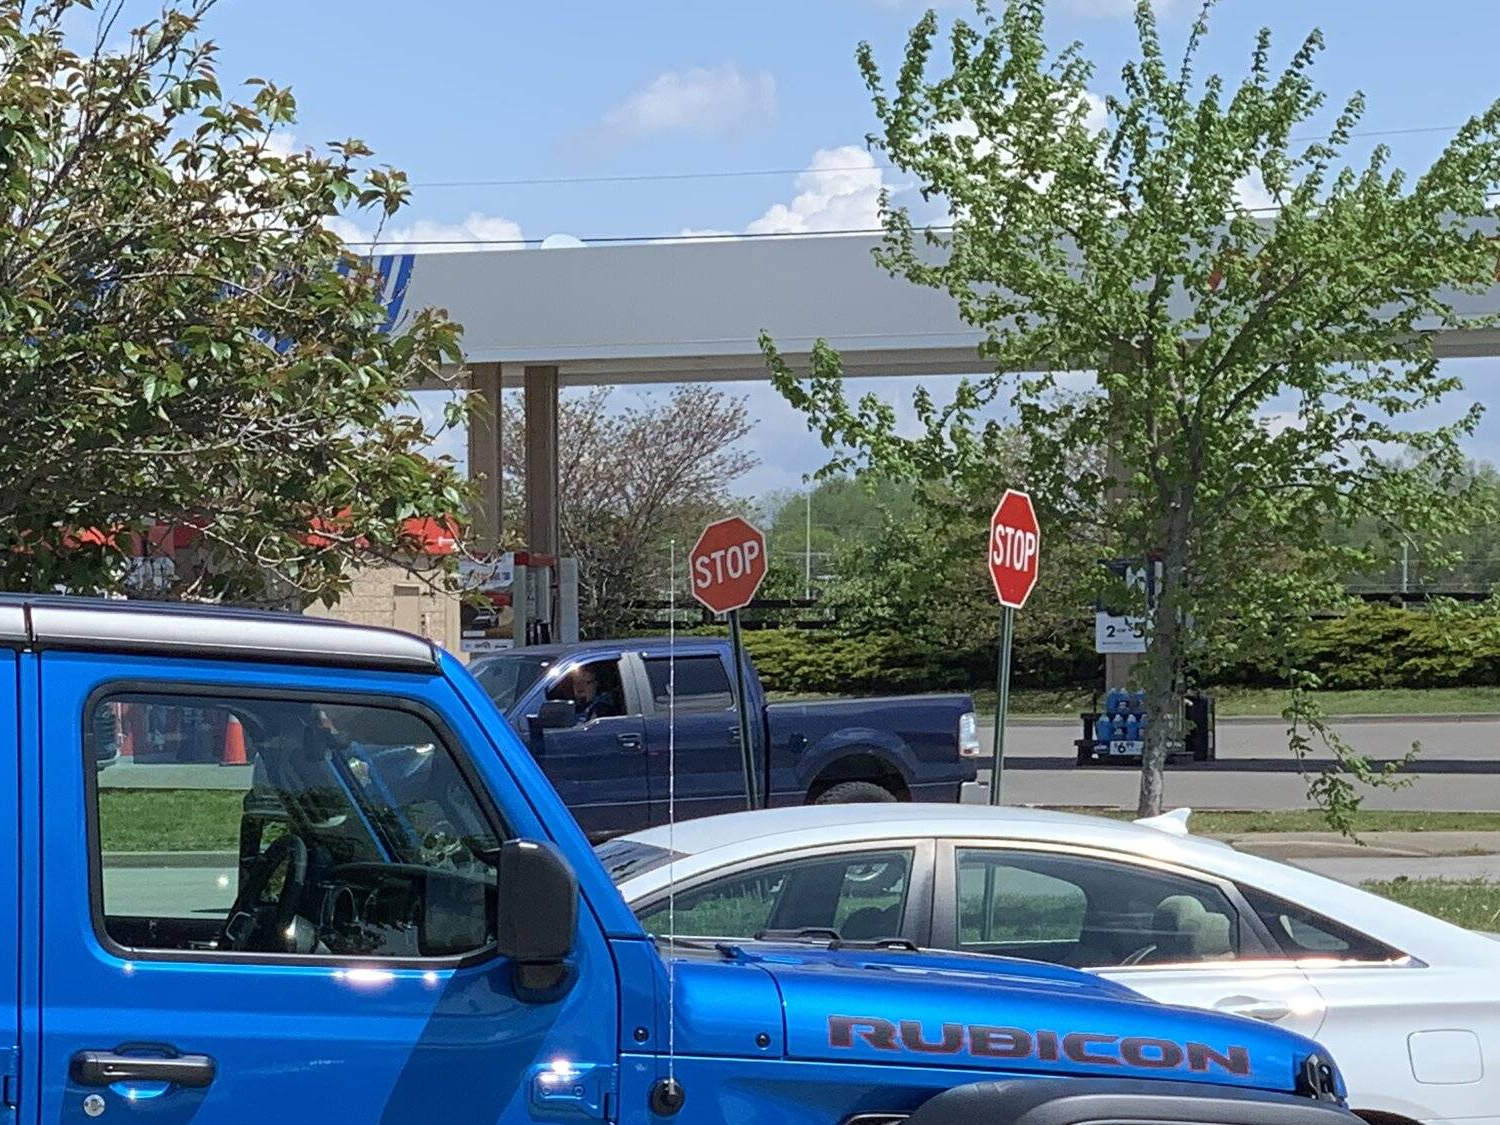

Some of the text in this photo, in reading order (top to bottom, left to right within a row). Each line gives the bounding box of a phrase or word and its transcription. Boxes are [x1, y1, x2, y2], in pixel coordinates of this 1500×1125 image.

[695, 540, 760, 589] STOP
[993, 523, 1036, 572] STOP
[1106, 625, 1116, 638] 2
[827, 1014, 1253, 1076] RUBICON
